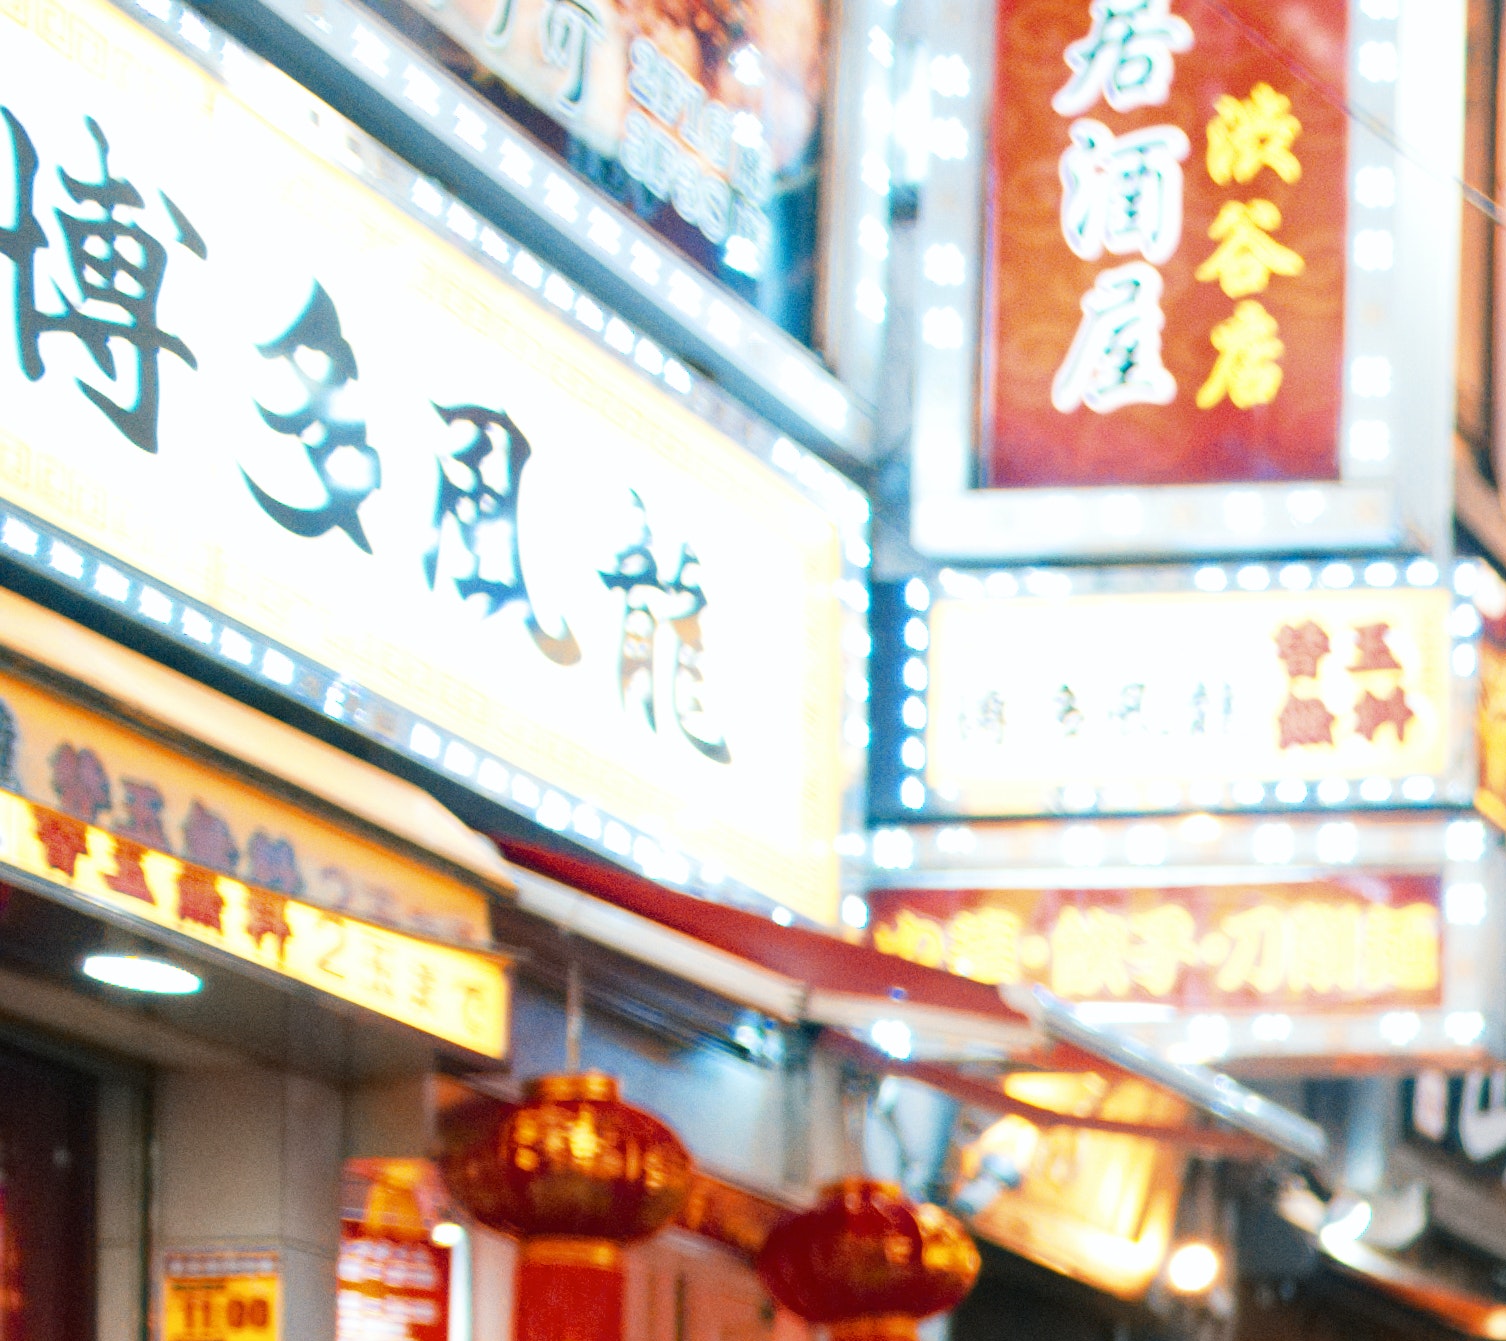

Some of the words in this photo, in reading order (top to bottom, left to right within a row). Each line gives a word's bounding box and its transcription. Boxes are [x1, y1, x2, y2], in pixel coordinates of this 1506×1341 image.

[1052, 0, 1193, 413] 居酒屋
[1196, 82, 1305, 409] 渋谷店
[0, 105, 733, 765] 博多風龍
